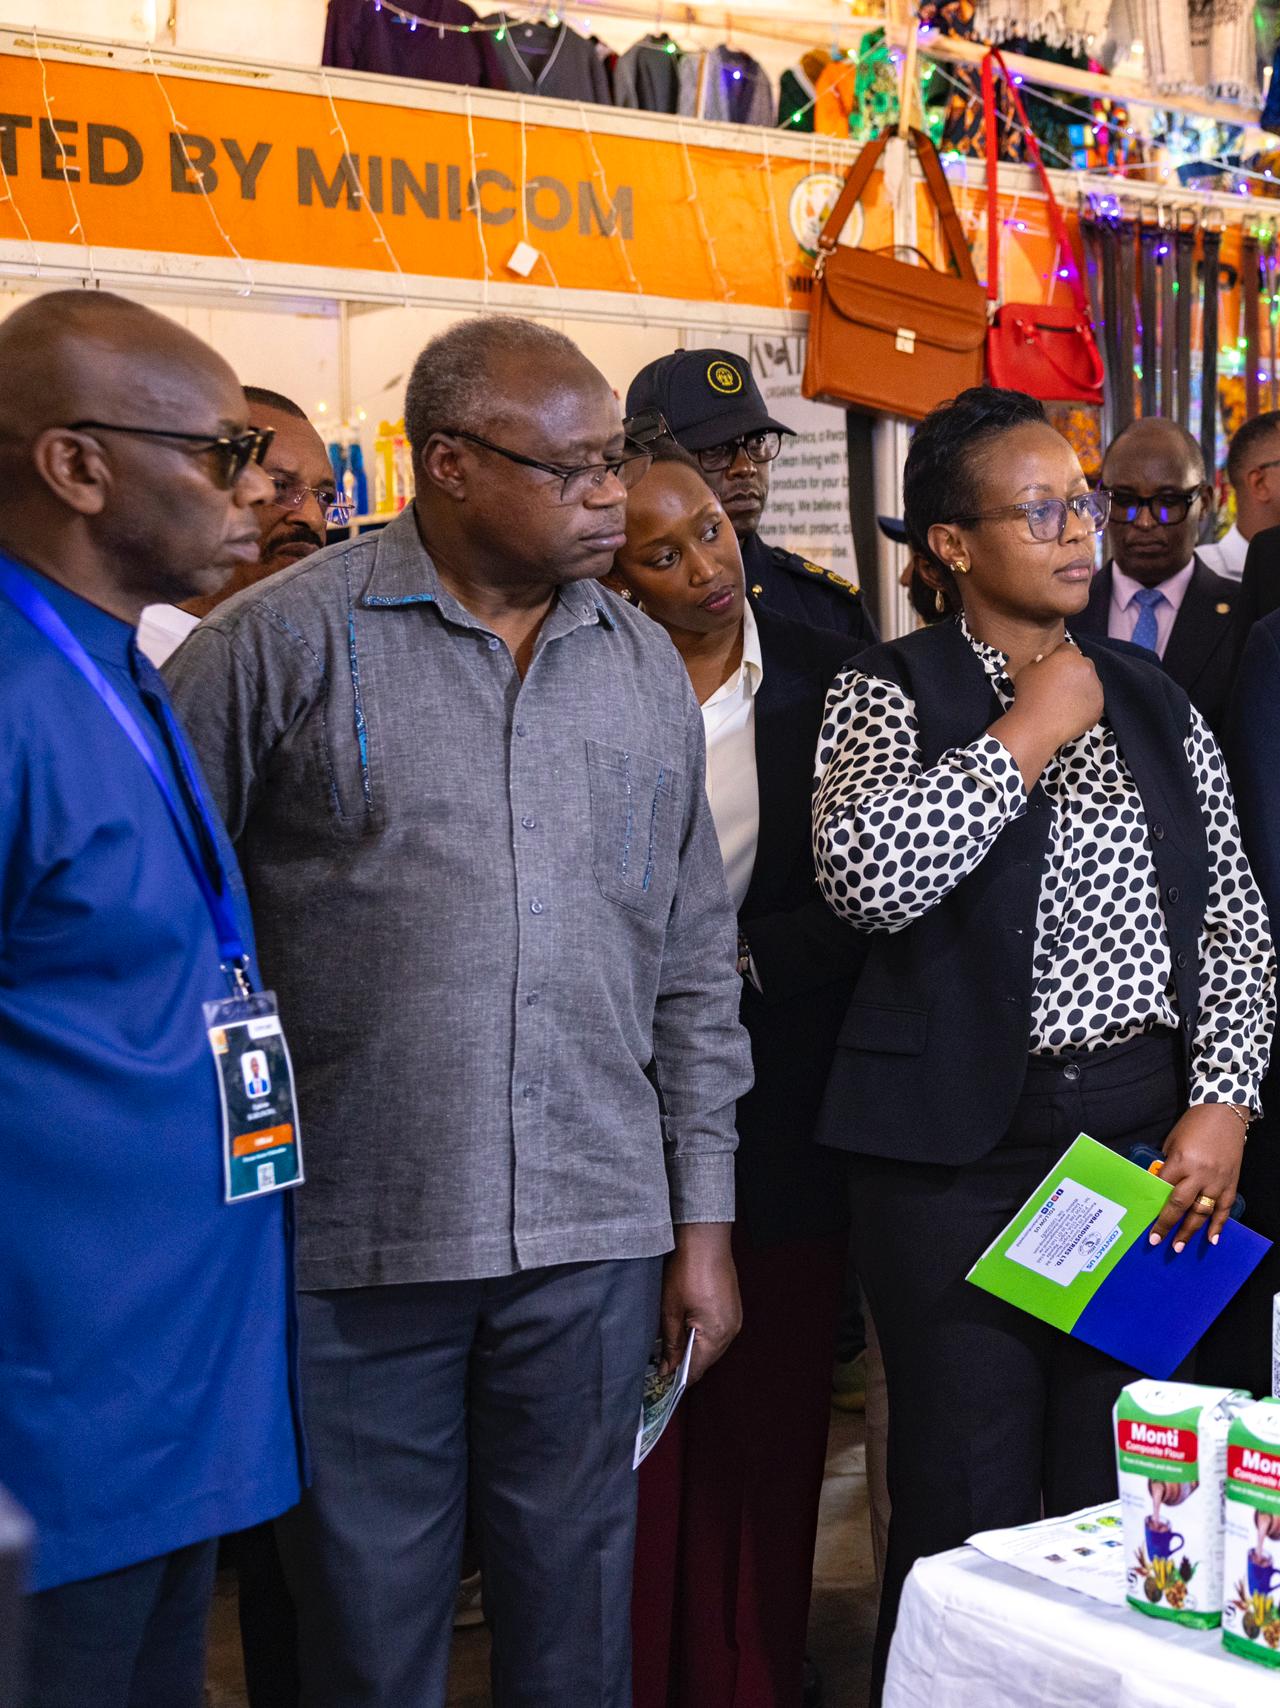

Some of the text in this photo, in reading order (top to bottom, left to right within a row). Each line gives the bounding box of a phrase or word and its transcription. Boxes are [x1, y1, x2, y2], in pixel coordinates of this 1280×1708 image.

[169, 132, 273, 200] BY
[296, 146, 634, 241] MINICOM
[1089, 1208, 1103, 1225] ROBA
[1064, 1222, 1091, 1256] INDUSTRIES
[1094, 1230, 1119, 1259] CONTACT
[1086, 1259, 1096, 1269] US
[1131, 1423, 1179, 1447] Monti
[1125, 1440, 1185, 1459] Composite Flour
